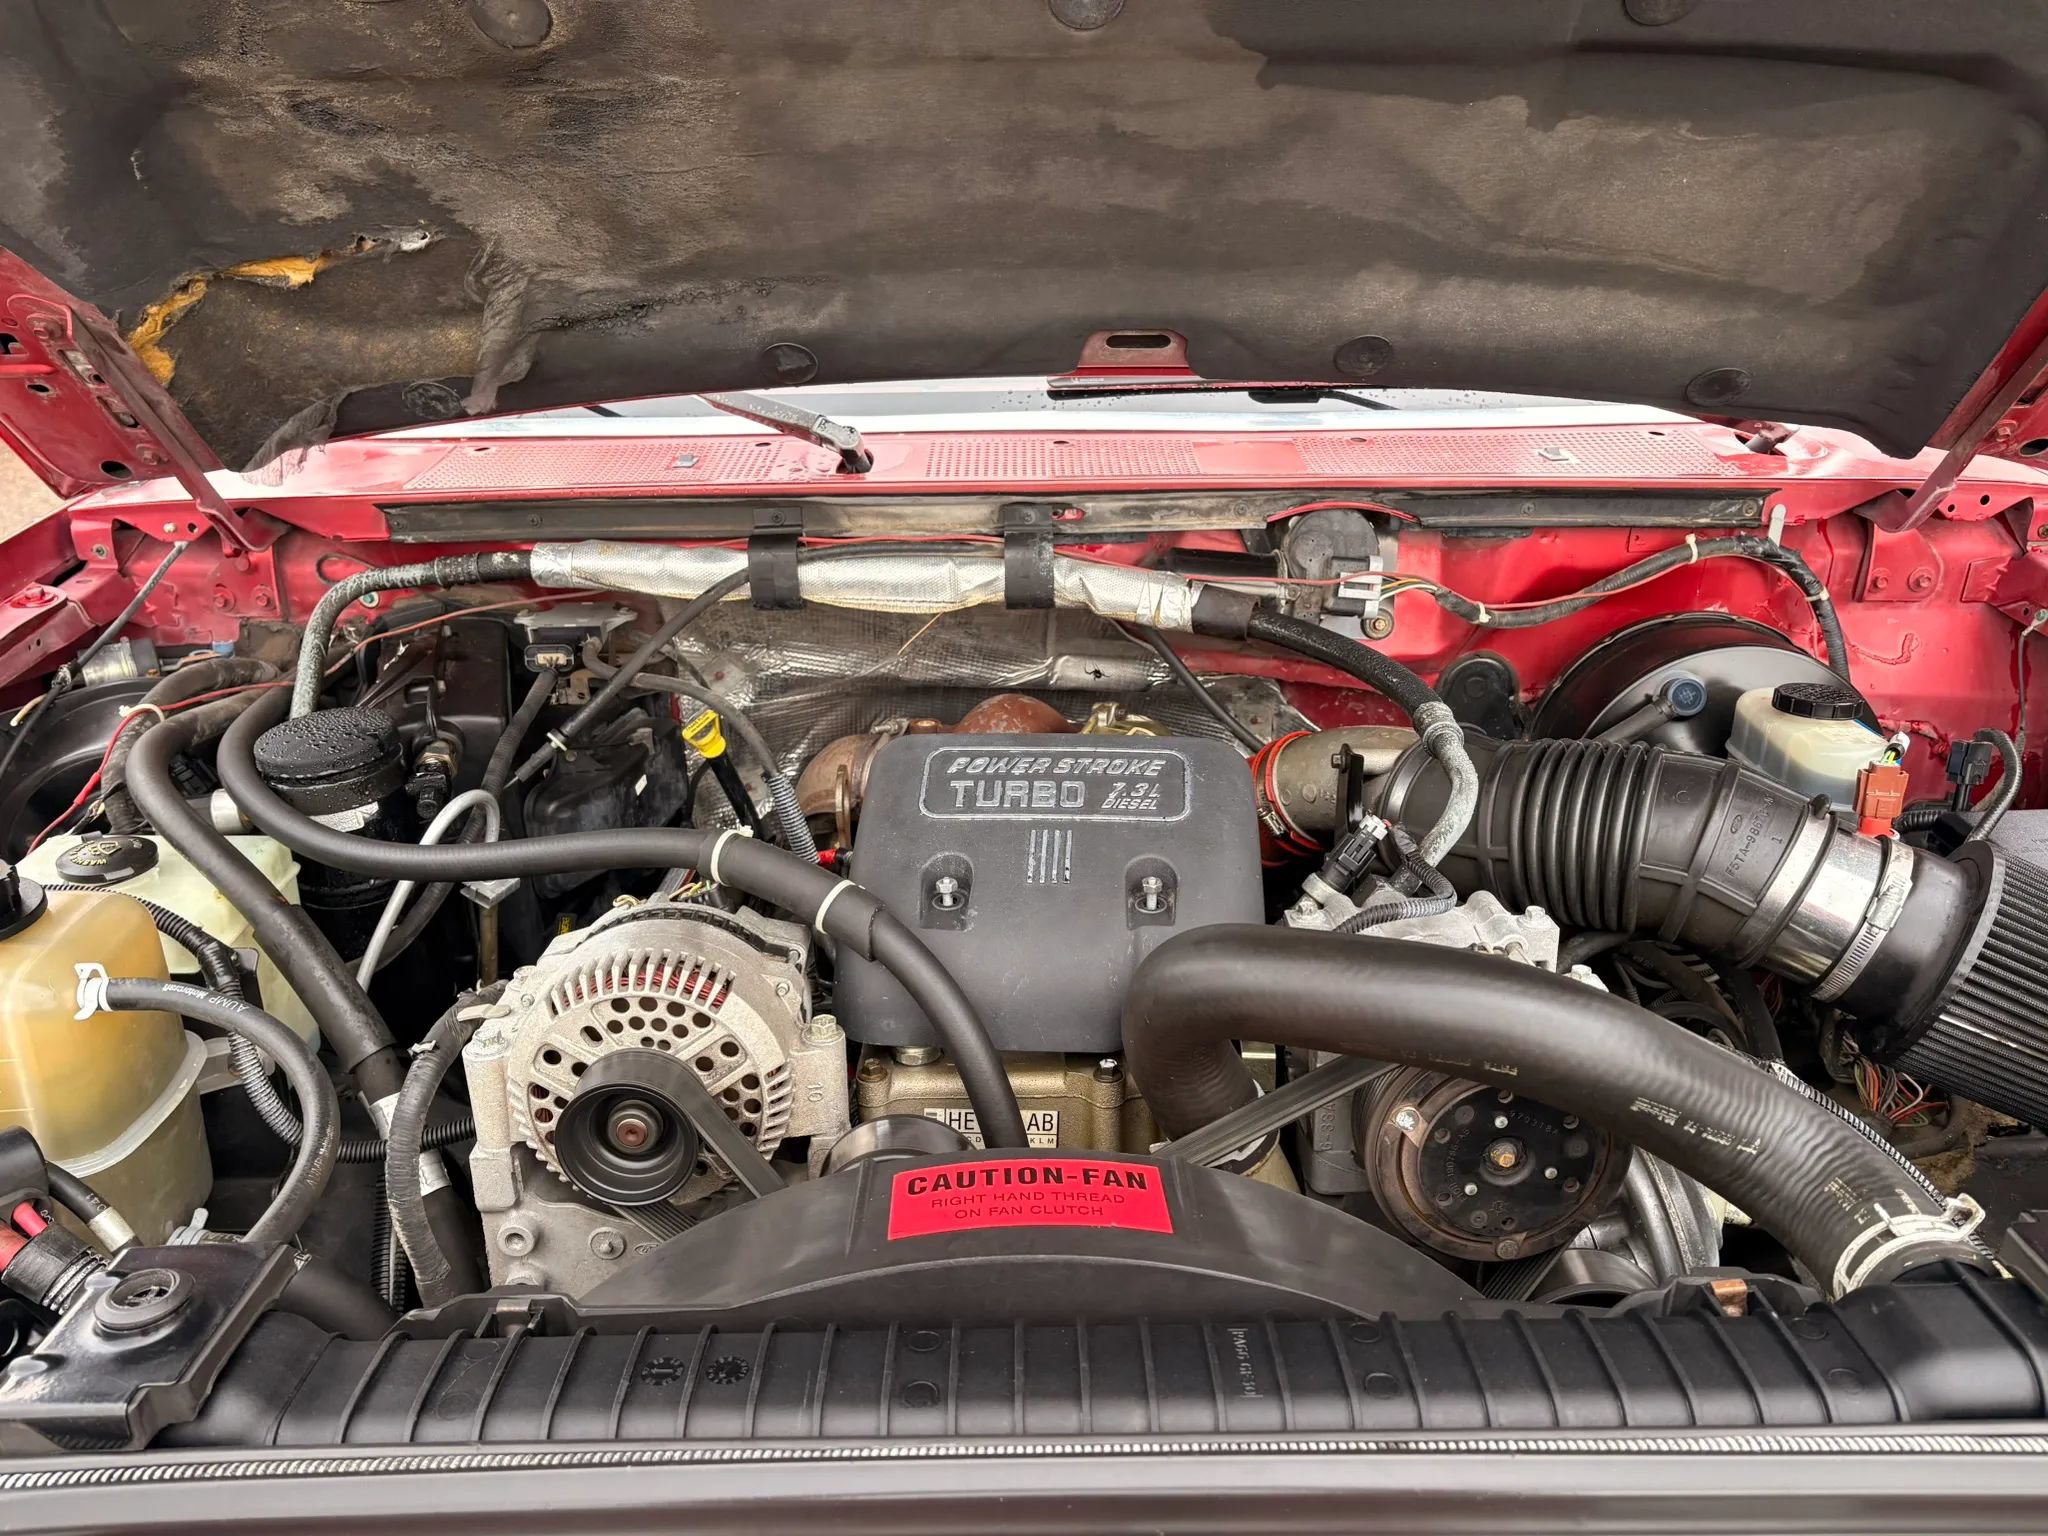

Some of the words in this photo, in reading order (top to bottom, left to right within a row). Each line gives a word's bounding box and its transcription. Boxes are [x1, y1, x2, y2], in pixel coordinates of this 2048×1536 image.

[947, 756, 1052, 775] POWER
[1053, 757, 1166, 776] STROKE
[950, 780, 1086, 808] TURBO
[1110, 782, 1161, 799] 7.3L
[1101, 798, 1160, 811] DIESEL
[907, 1167, 1148, 1195] CAUTION-FAN
[931, 1193, 987, 1208] RIGHT
[993, 1191, 1045, 1202] HAND
[1051, 1191, 1125, 1204] THREAD
[954, 1207, 982, 1220] ON
[988, 1205, 1023, 1217] FAN
[1029, 1204, 1104, 1216] CLUTCH
